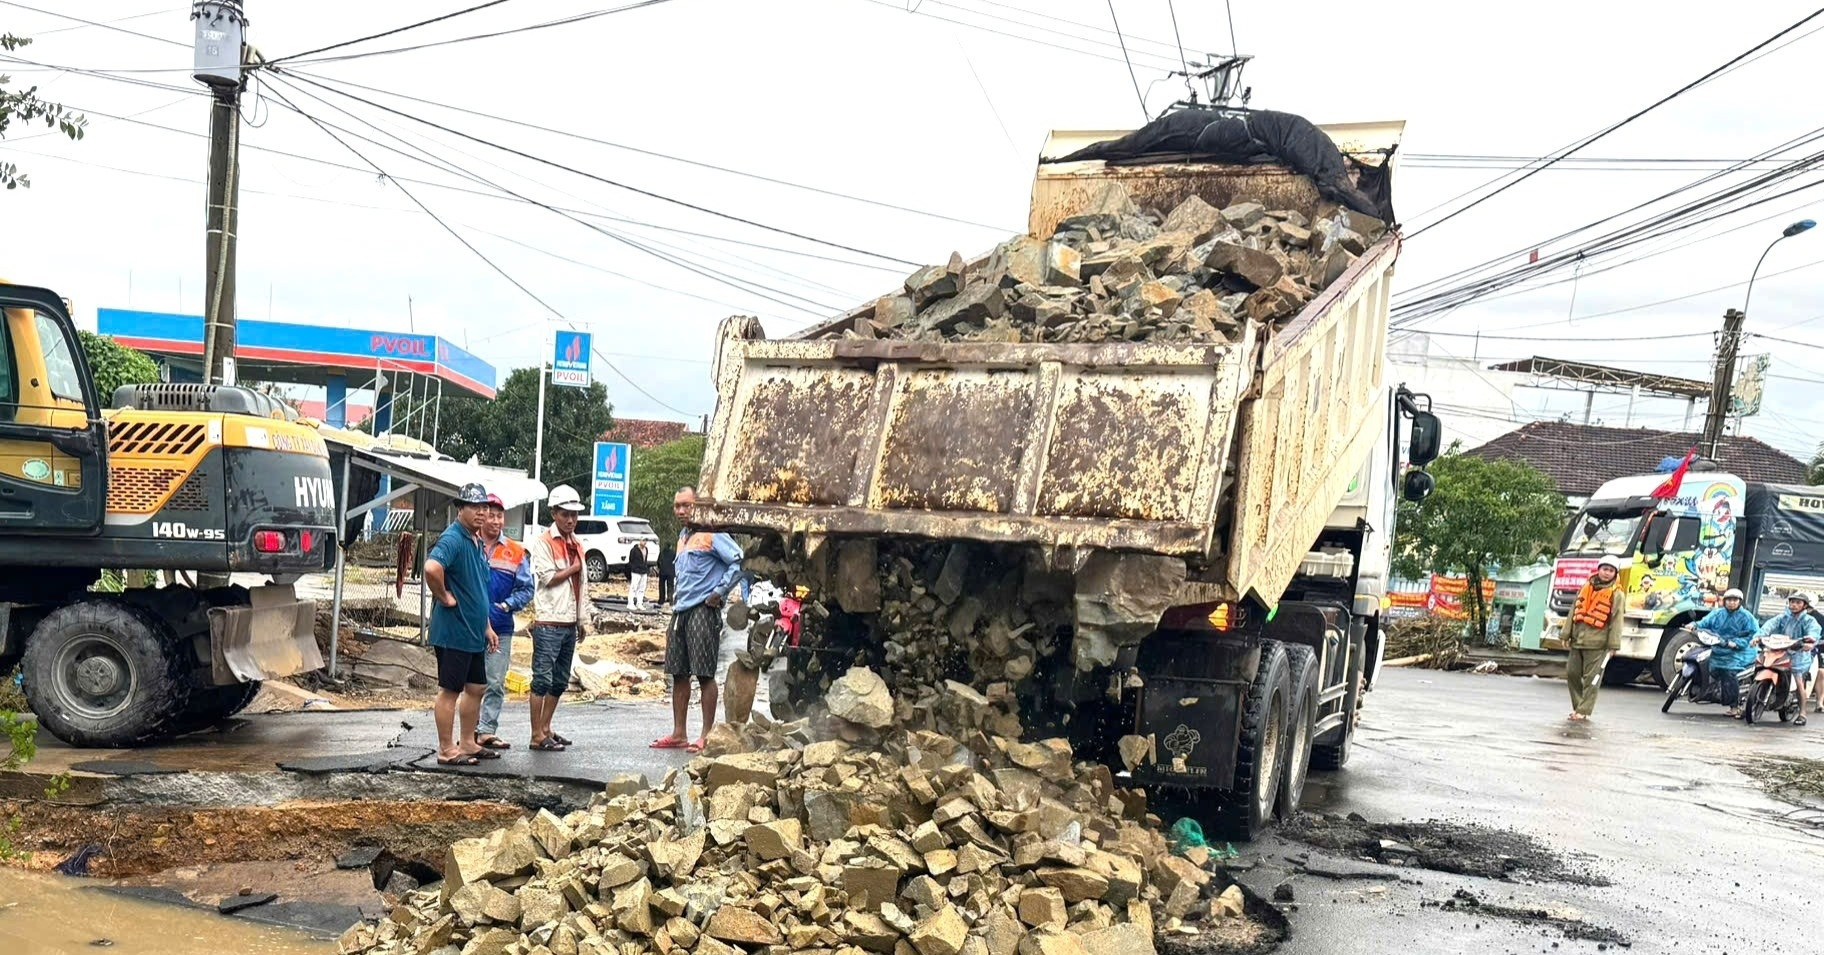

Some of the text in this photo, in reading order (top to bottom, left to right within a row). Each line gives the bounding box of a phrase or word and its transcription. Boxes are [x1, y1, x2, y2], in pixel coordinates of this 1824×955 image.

[371, 336, 428, 356] PVOIL
[556, 371, 585, 382] PVOIL
[598, 481, 620, 489] PVOIL
